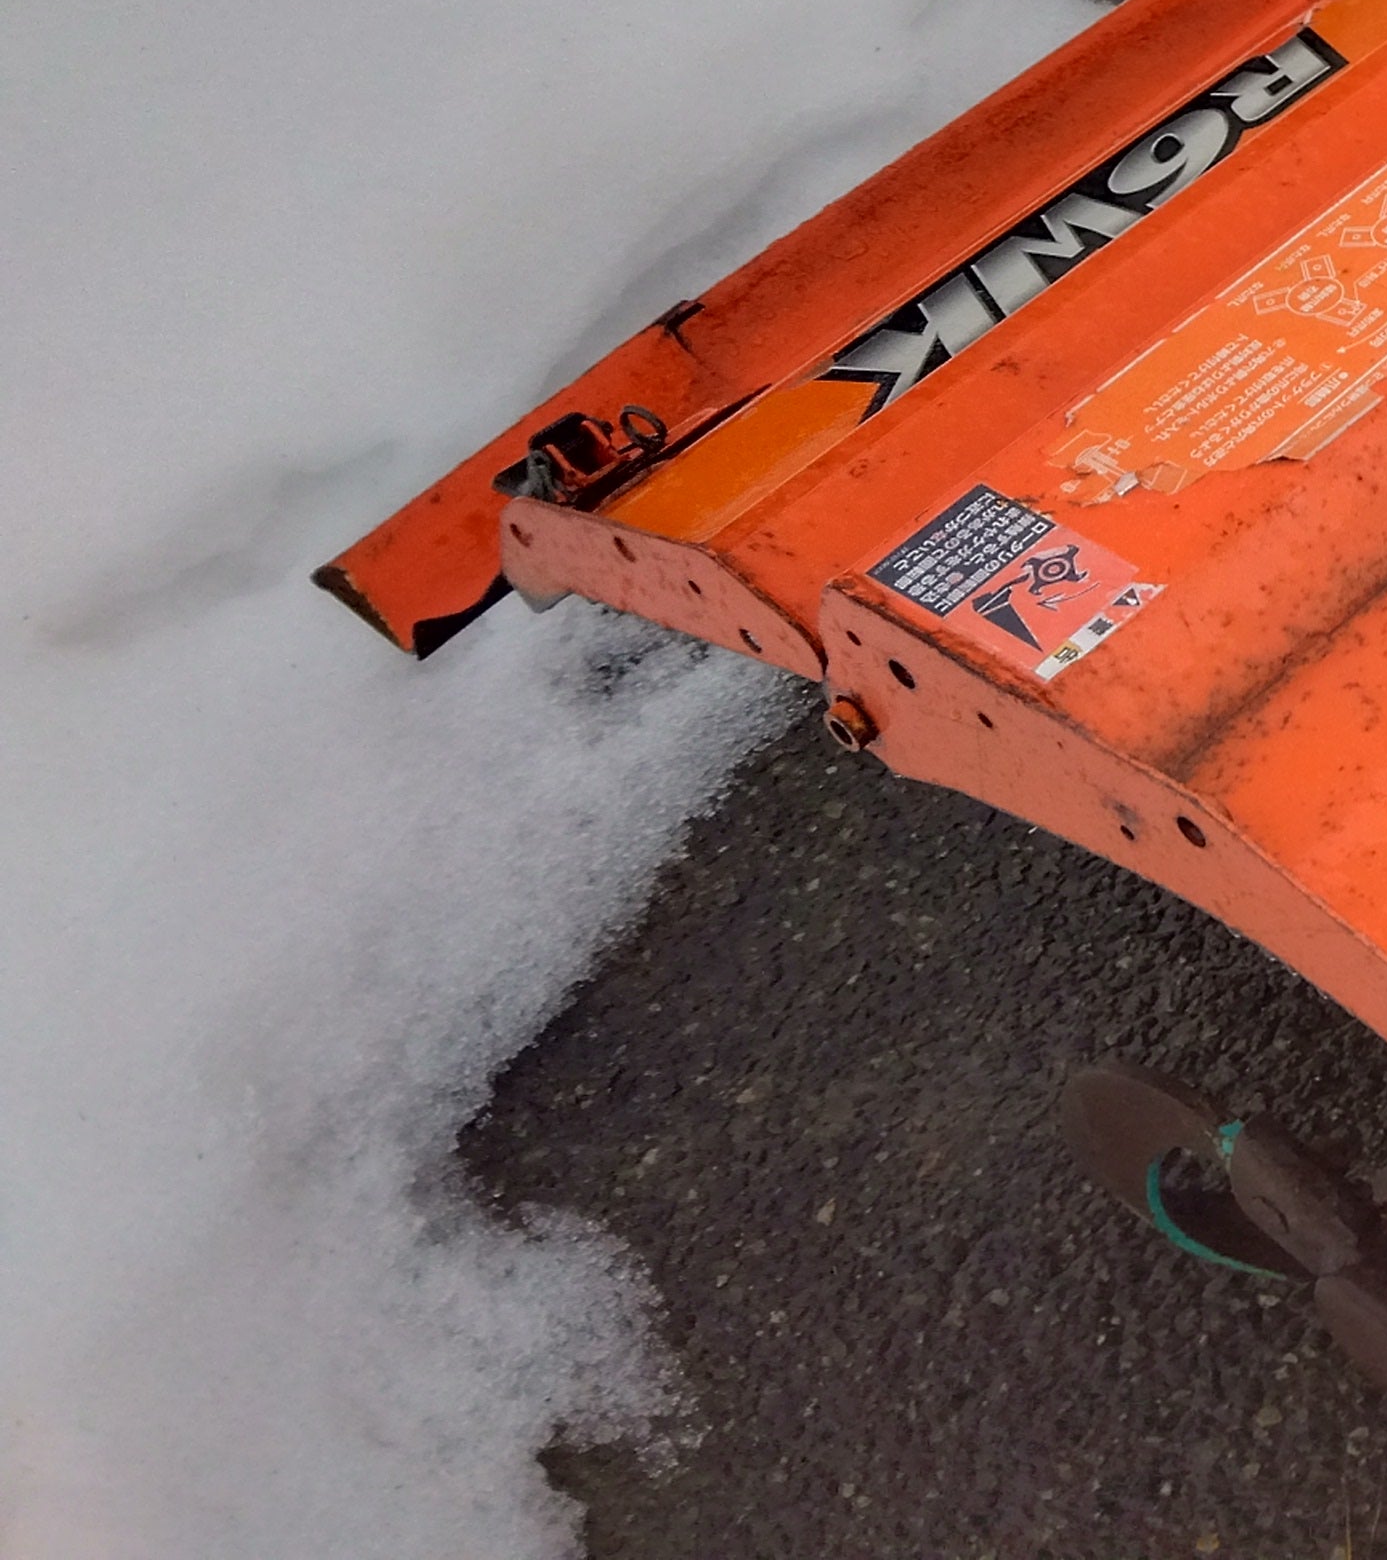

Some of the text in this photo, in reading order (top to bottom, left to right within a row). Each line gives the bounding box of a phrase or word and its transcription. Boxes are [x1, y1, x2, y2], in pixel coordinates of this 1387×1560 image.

[891, 491, 996, 572] に近づかないこと
